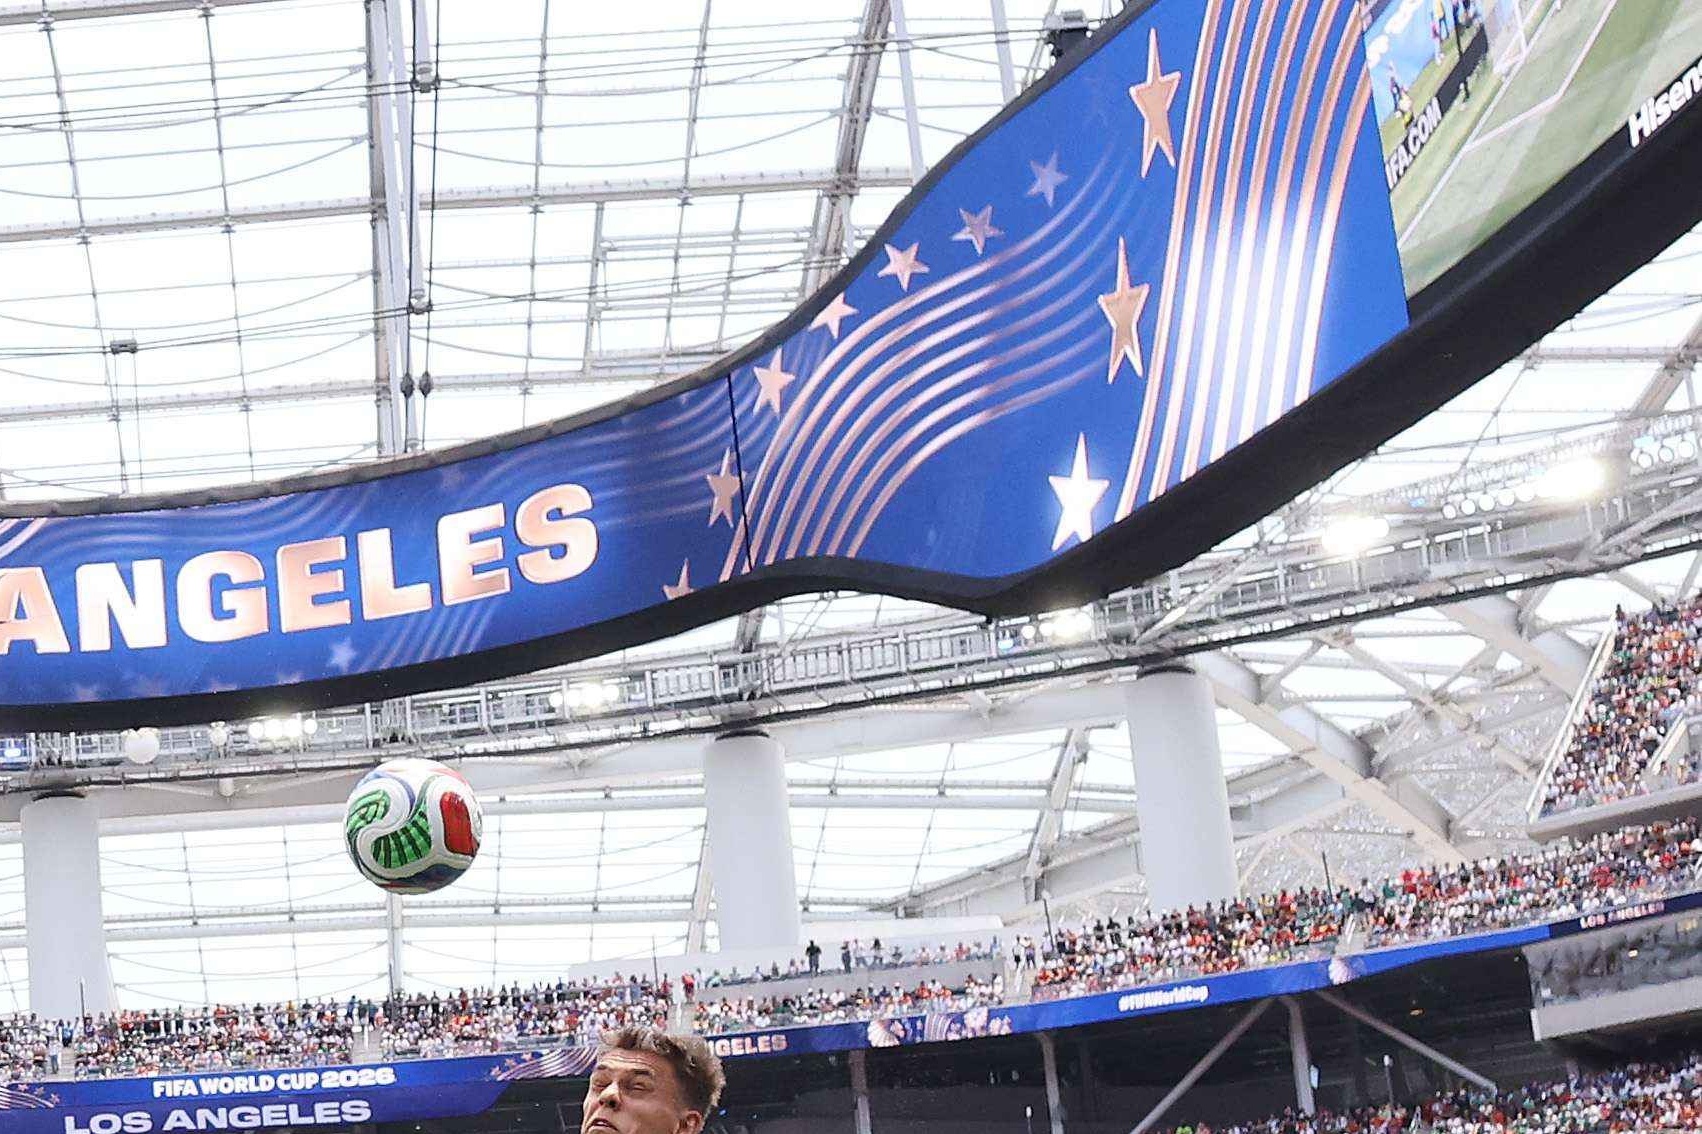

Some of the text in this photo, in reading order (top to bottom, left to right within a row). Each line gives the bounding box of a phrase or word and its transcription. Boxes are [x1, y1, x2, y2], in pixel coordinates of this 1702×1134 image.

[153, 1067, 395, 1098] FIFA WORLD CUP 2026
[163, 1100, 372, 1131] ANGELES
